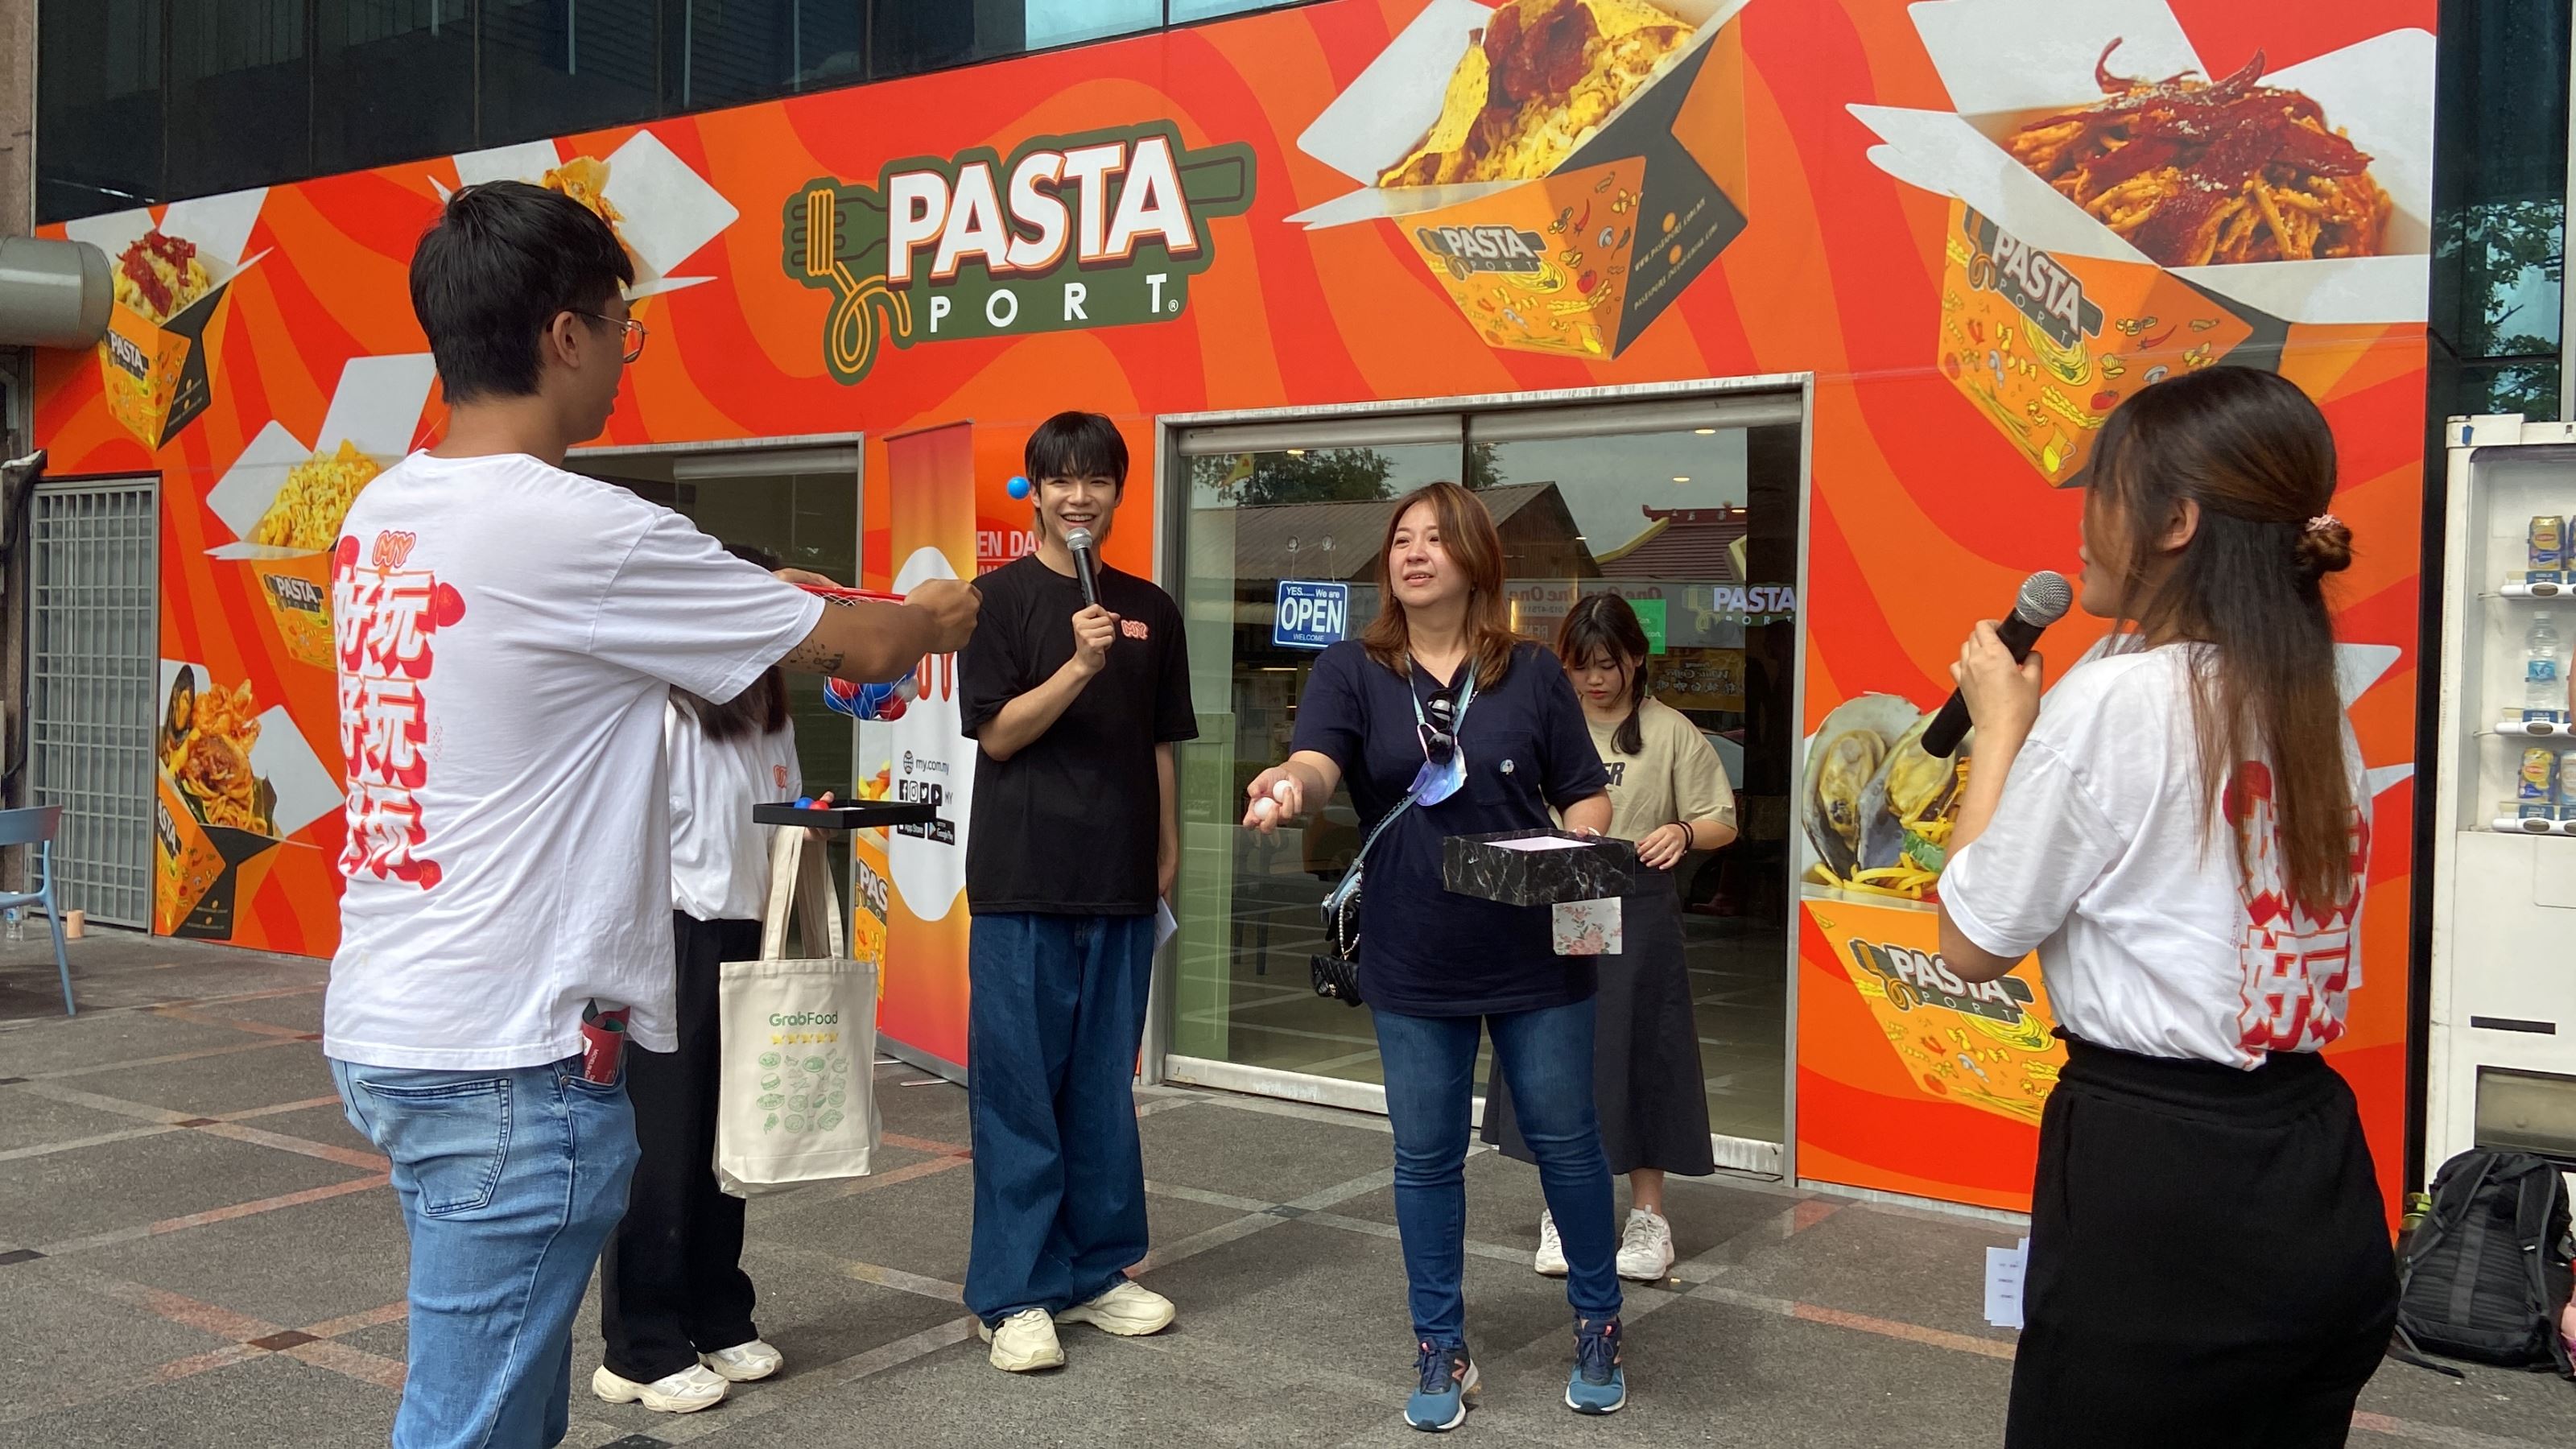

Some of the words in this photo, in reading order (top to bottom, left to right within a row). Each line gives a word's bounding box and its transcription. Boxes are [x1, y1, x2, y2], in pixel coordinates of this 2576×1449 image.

[887, 134, 1199, 286] PASTA
[1441, 228, 1535, 258] PASTA
[1470, 260, 1535, 272] PORT
[1992, 226, 2080, 334] PASTA
[1999, 278, 2068, 344] PORT
[110, 331, 144, 373] PASTA
[372, 530, 416, 567] MY
[976, 530, 1002, 557] EN
[1009, 530, 1038, 557] DA
[275, 576, 319, 605] PASTA
[1713, 586, 1796, 613] PASTA
[1121, 619, 1148, 640] MY
[1281, 597, 1343, 634] OPEN
[1293, 633, 1325, 642] WELCOME
[860, 861, 888, 911] PAS
[769, 1011, 839, 1027] GrabFood
[1922, 990, 2012, 1022] PORT
